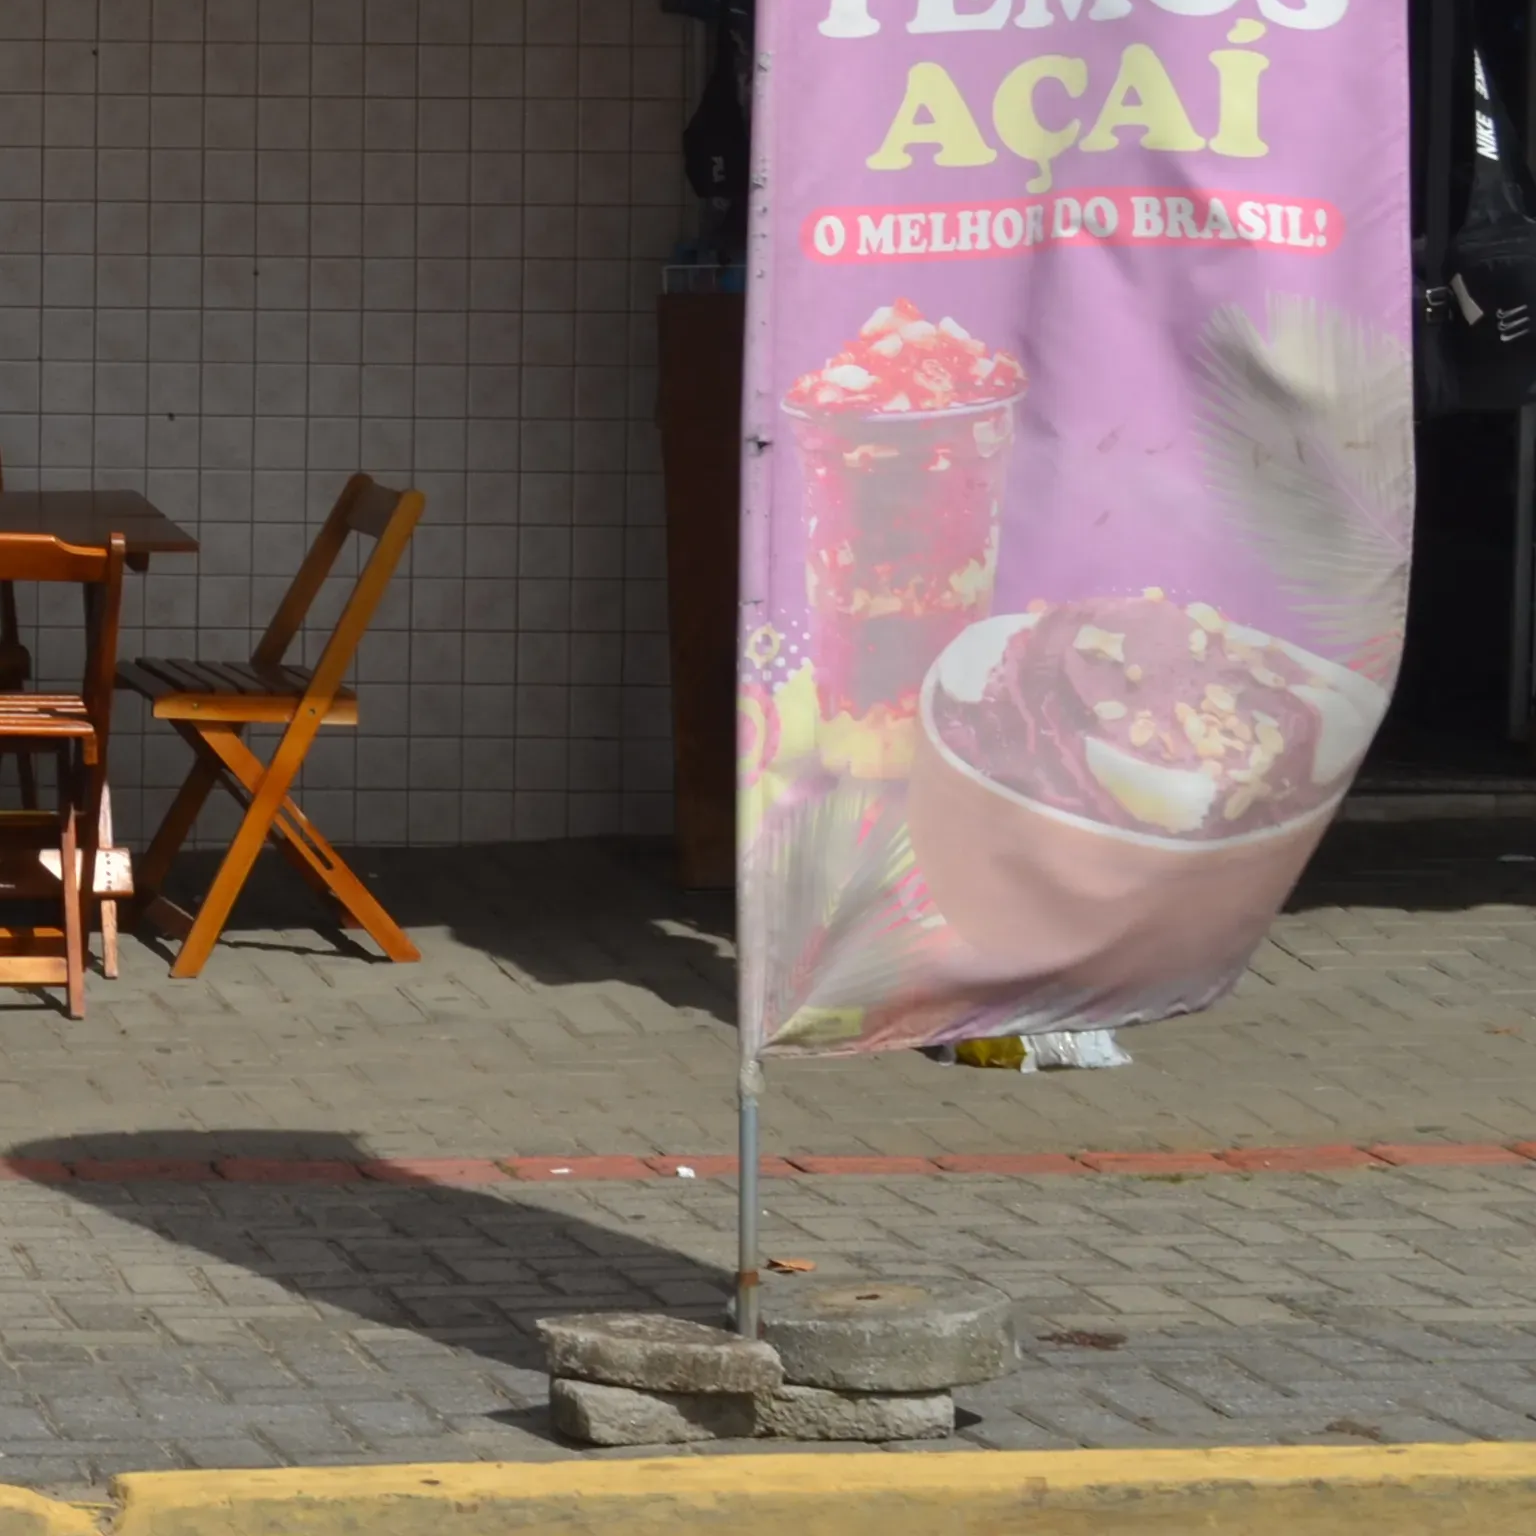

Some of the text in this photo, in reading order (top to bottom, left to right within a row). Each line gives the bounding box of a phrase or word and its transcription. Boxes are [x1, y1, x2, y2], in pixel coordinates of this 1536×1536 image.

[865, 18, 1270, 193] AÇAÍ
[1474, 108, 1500, 162] NIKE
[814, 217, 846, 256] O
[1054, 197, 1118, 239] DO
[1131, 196, 1328, 247] BRASIL!
